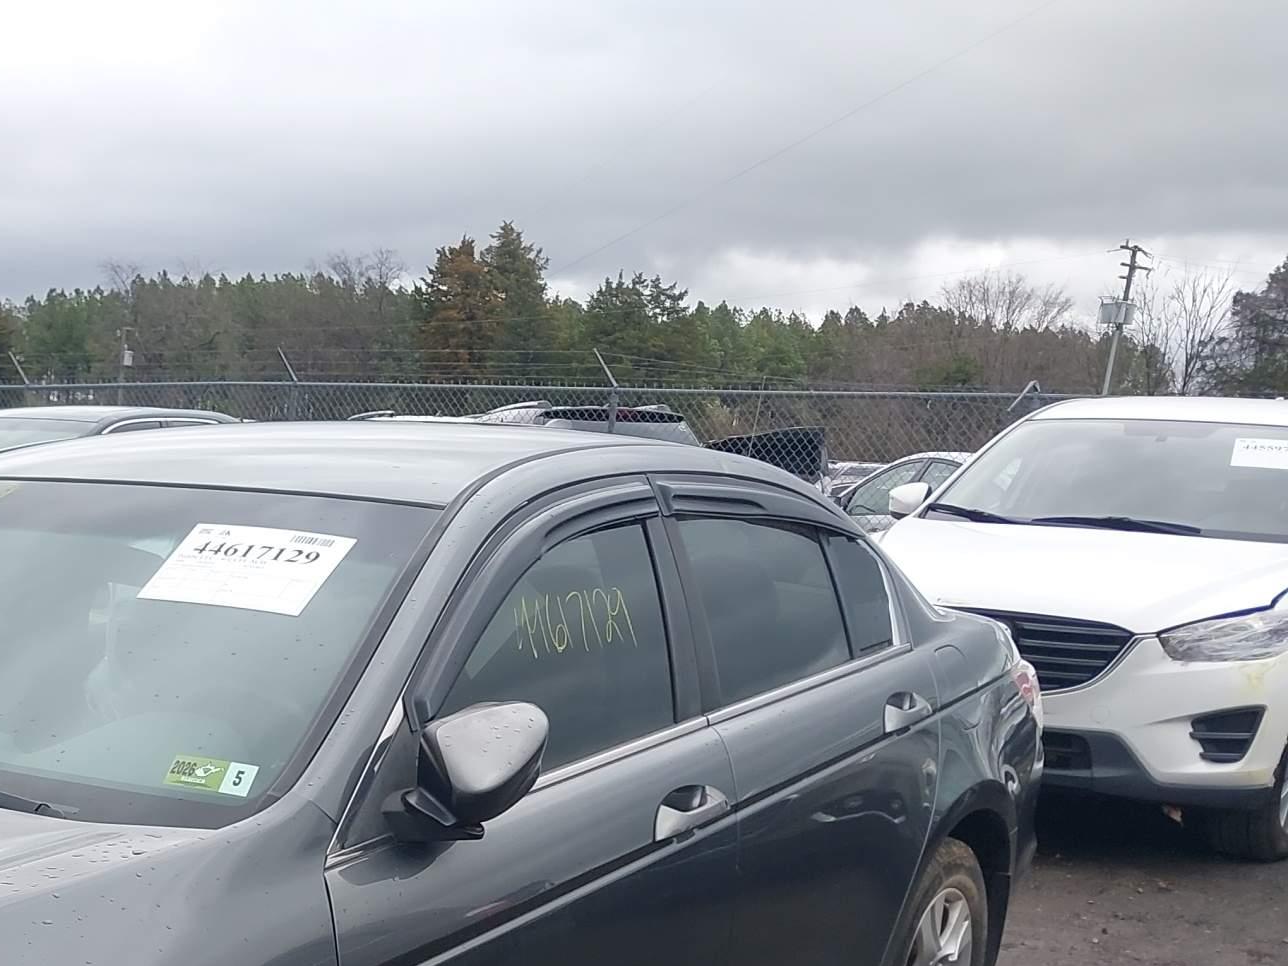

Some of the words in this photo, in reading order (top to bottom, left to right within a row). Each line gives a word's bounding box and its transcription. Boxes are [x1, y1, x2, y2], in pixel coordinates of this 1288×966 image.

[193, 541, 320, 564] 44617129
[170, 760, 197, 777] 2026
[232, 770, 245, 786] 5
